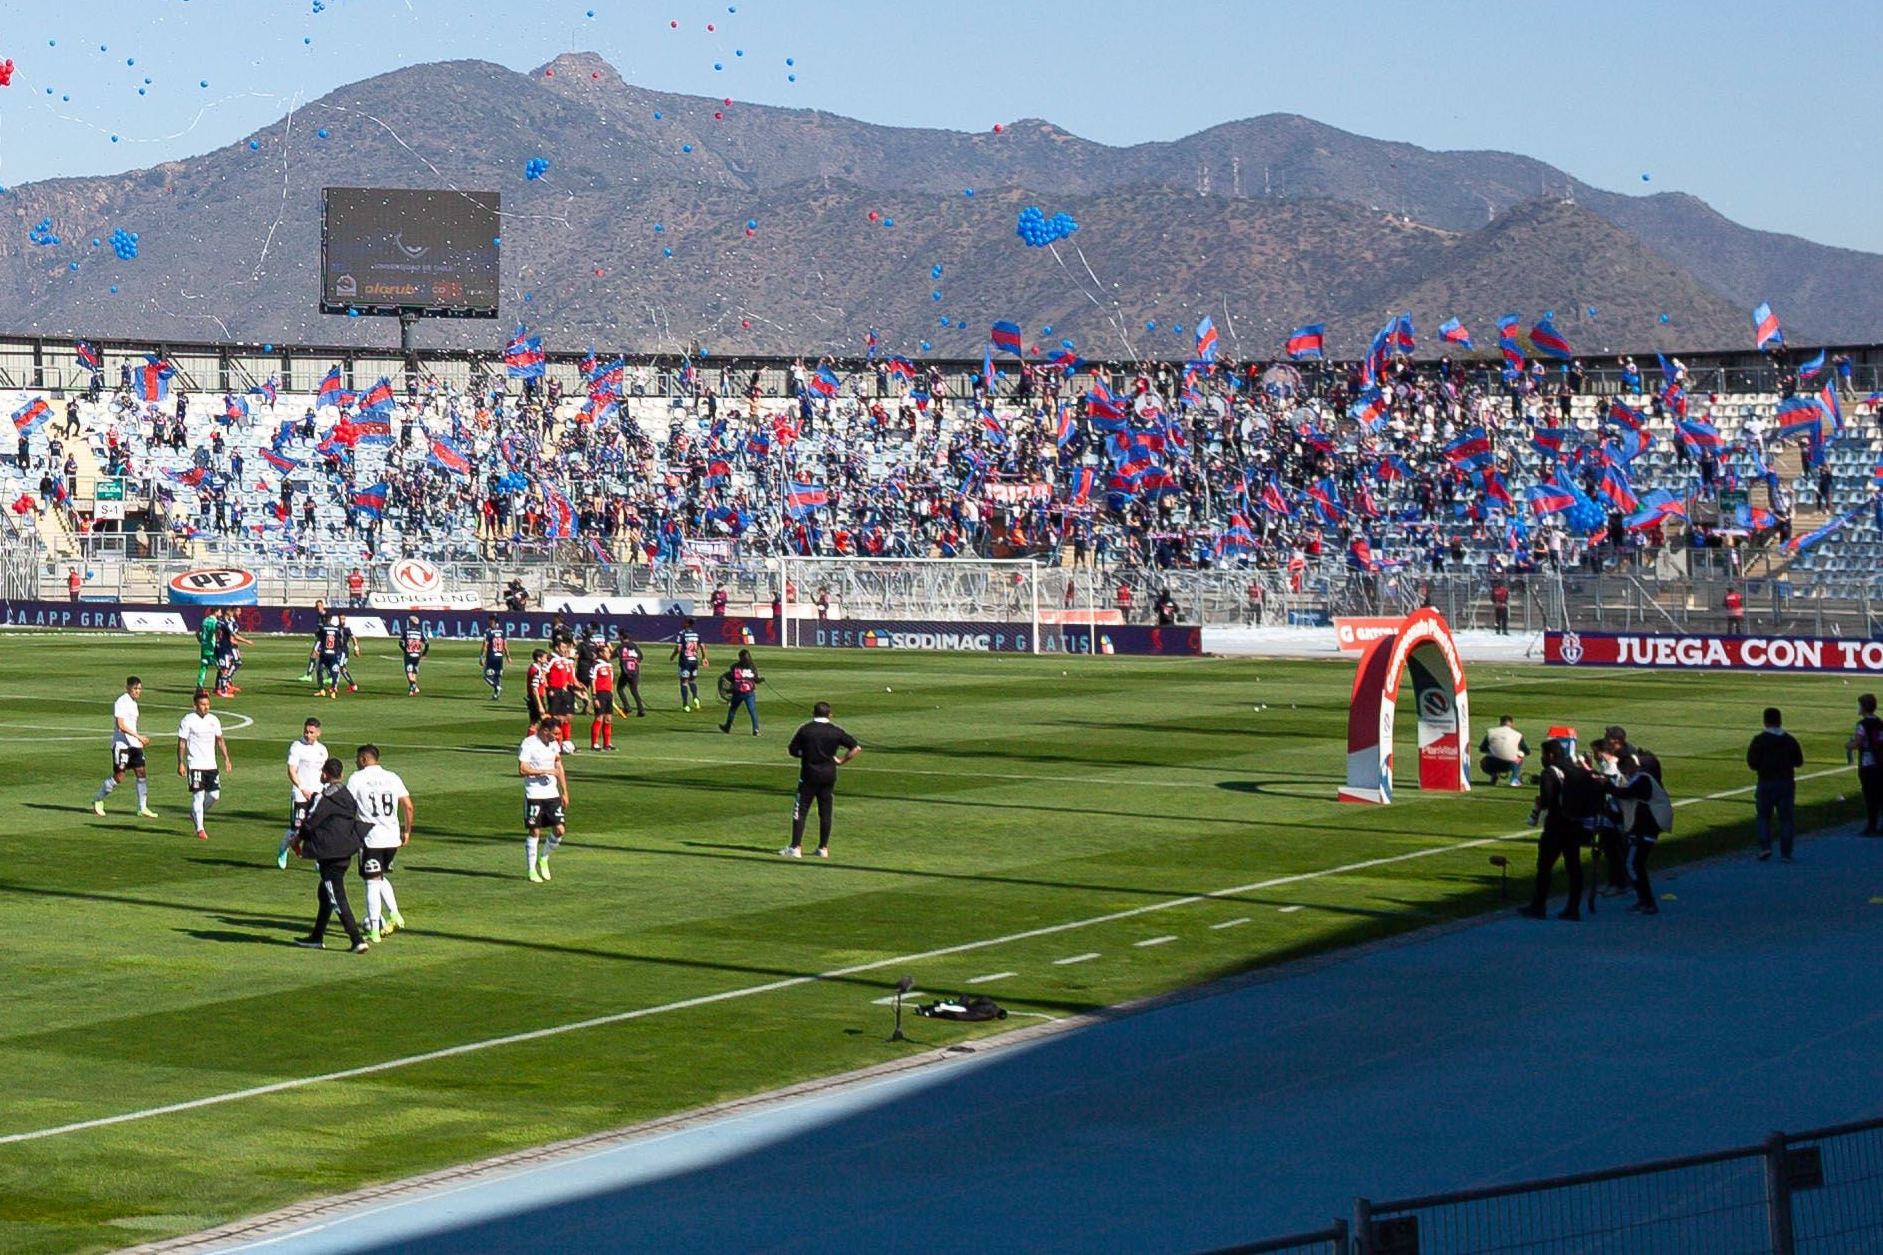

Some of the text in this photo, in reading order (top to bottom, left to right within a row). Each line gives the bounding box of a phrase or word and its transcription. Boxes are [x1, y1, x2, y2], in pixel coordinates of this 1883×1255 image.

[101, 504, 119, 515] S-1
[189, 572, 232, 589] PF
[36, 610, 71, 627] APP
[392, 618, 447, 637] AGA
[457, 620, 480, 638] LA
[891, 632, 990, 651] SODIMAC
[1016, 634, 1089, 653] GATIS
[1617, 637, 1883, 670] JUEGA CON TO
